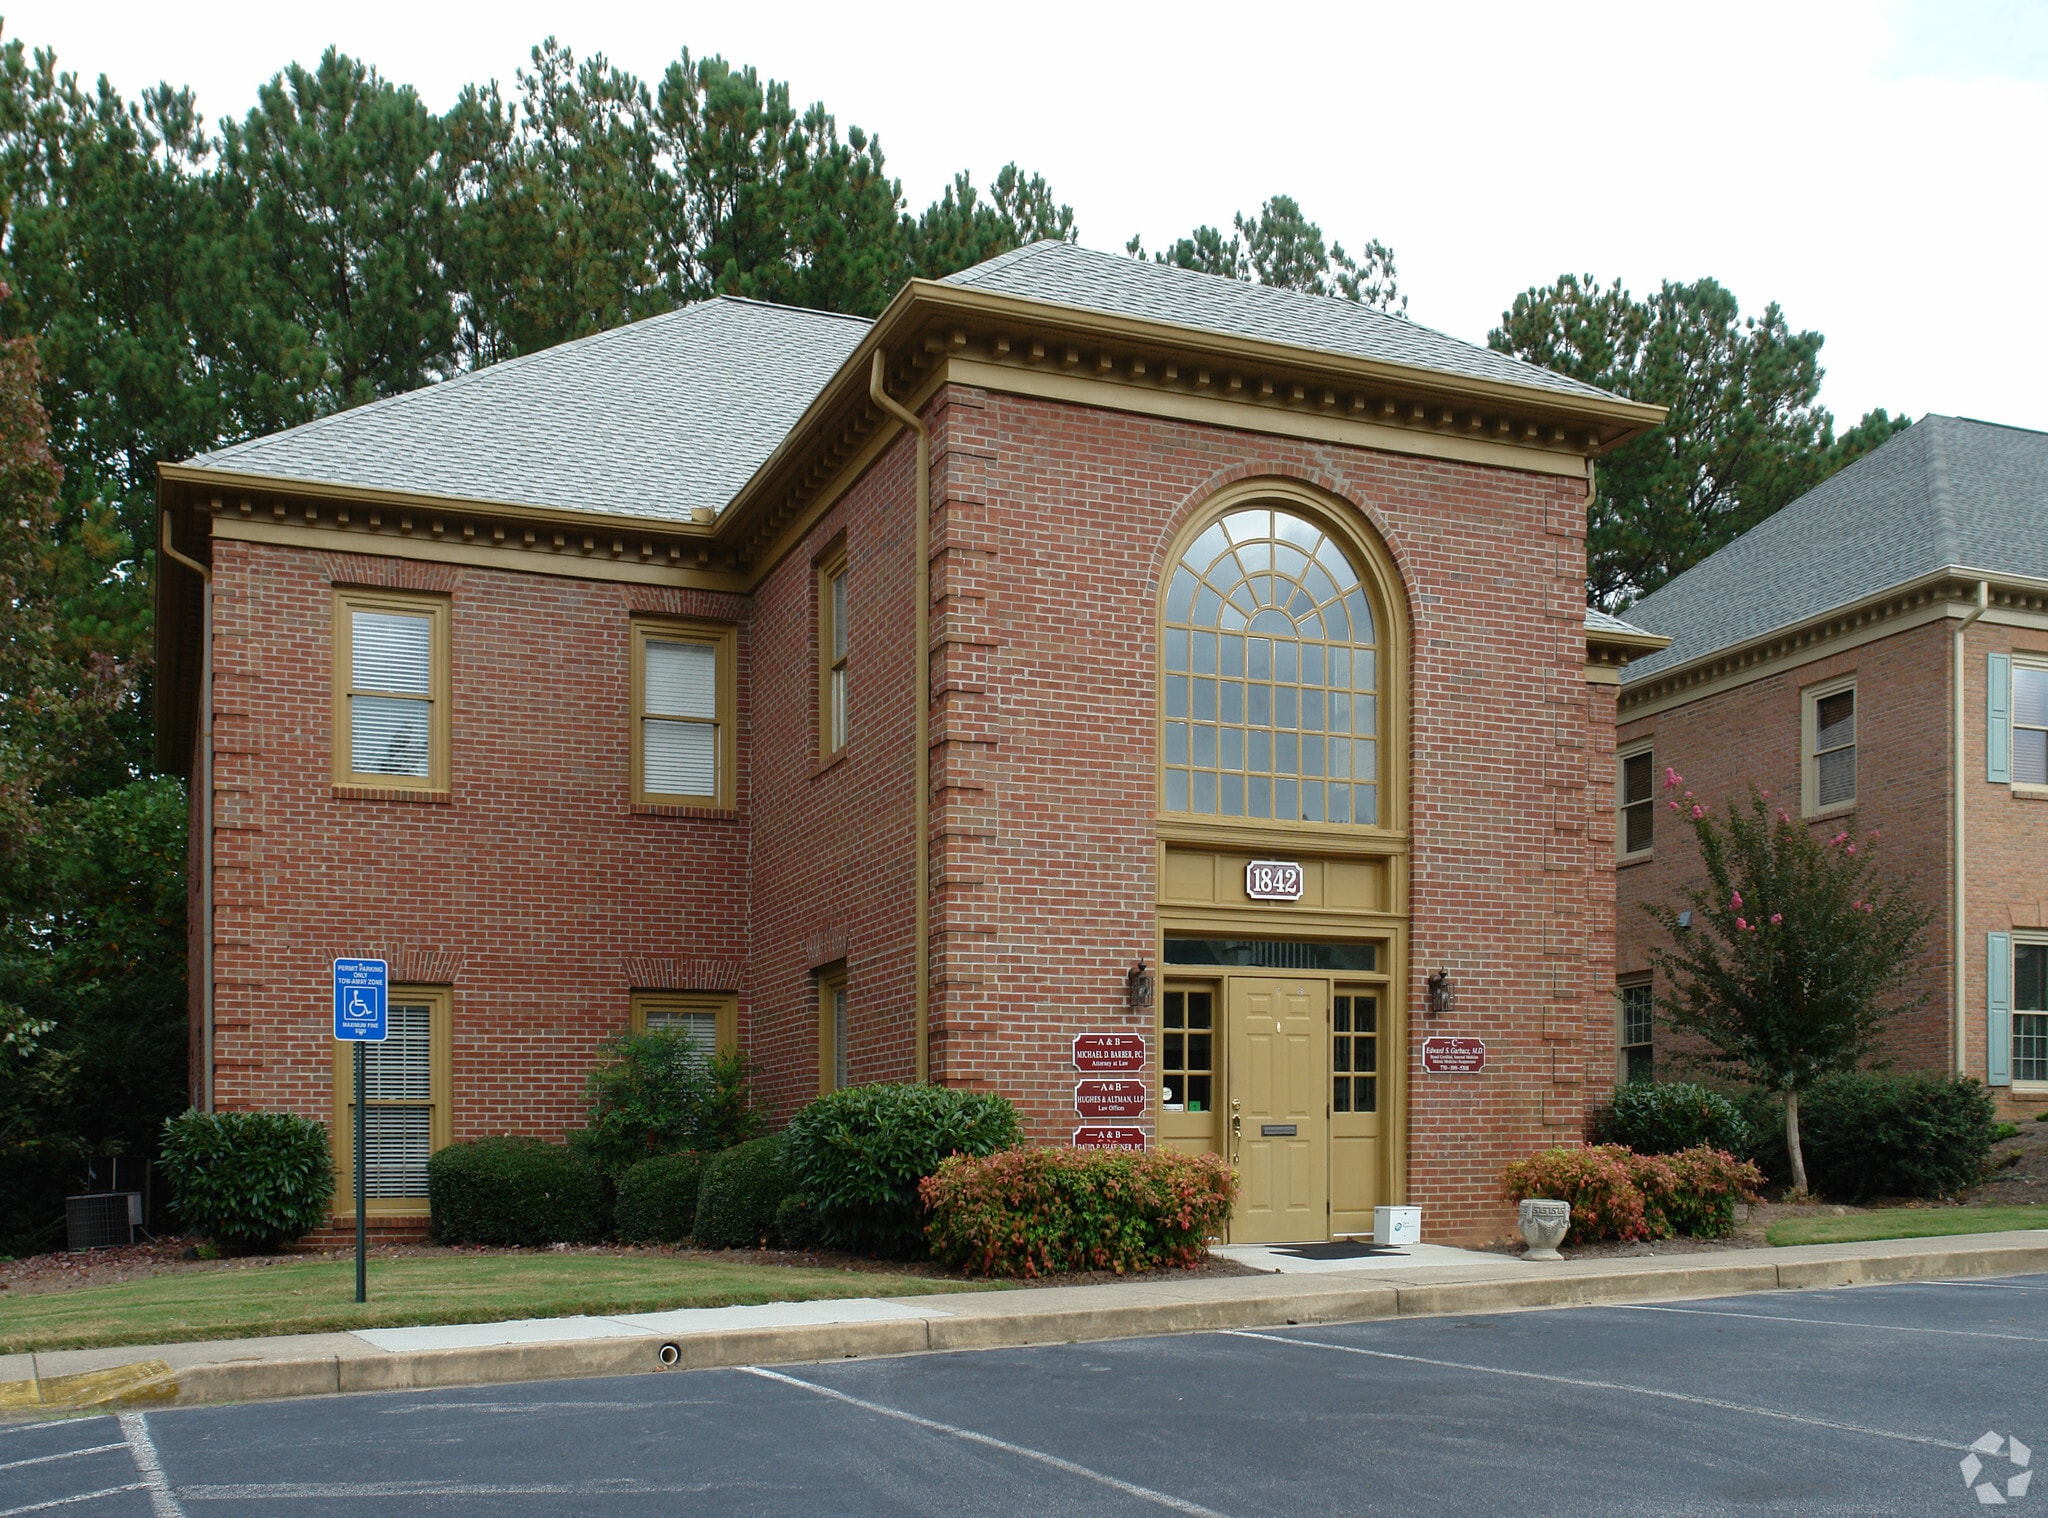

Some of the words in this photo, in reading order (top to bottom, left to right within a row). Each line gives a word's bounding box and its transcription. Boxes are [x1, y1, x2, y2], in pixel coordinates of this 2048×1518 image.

[1254, 868, 1296, 893] 1842
[1077, 1050, 1103, 1058] MICHAEL
[1110, 1050, 1134, 1059] BARBER,
[1100, 1083, 1108, 1091] A
[1116, 1083, 1121, 1091] B
